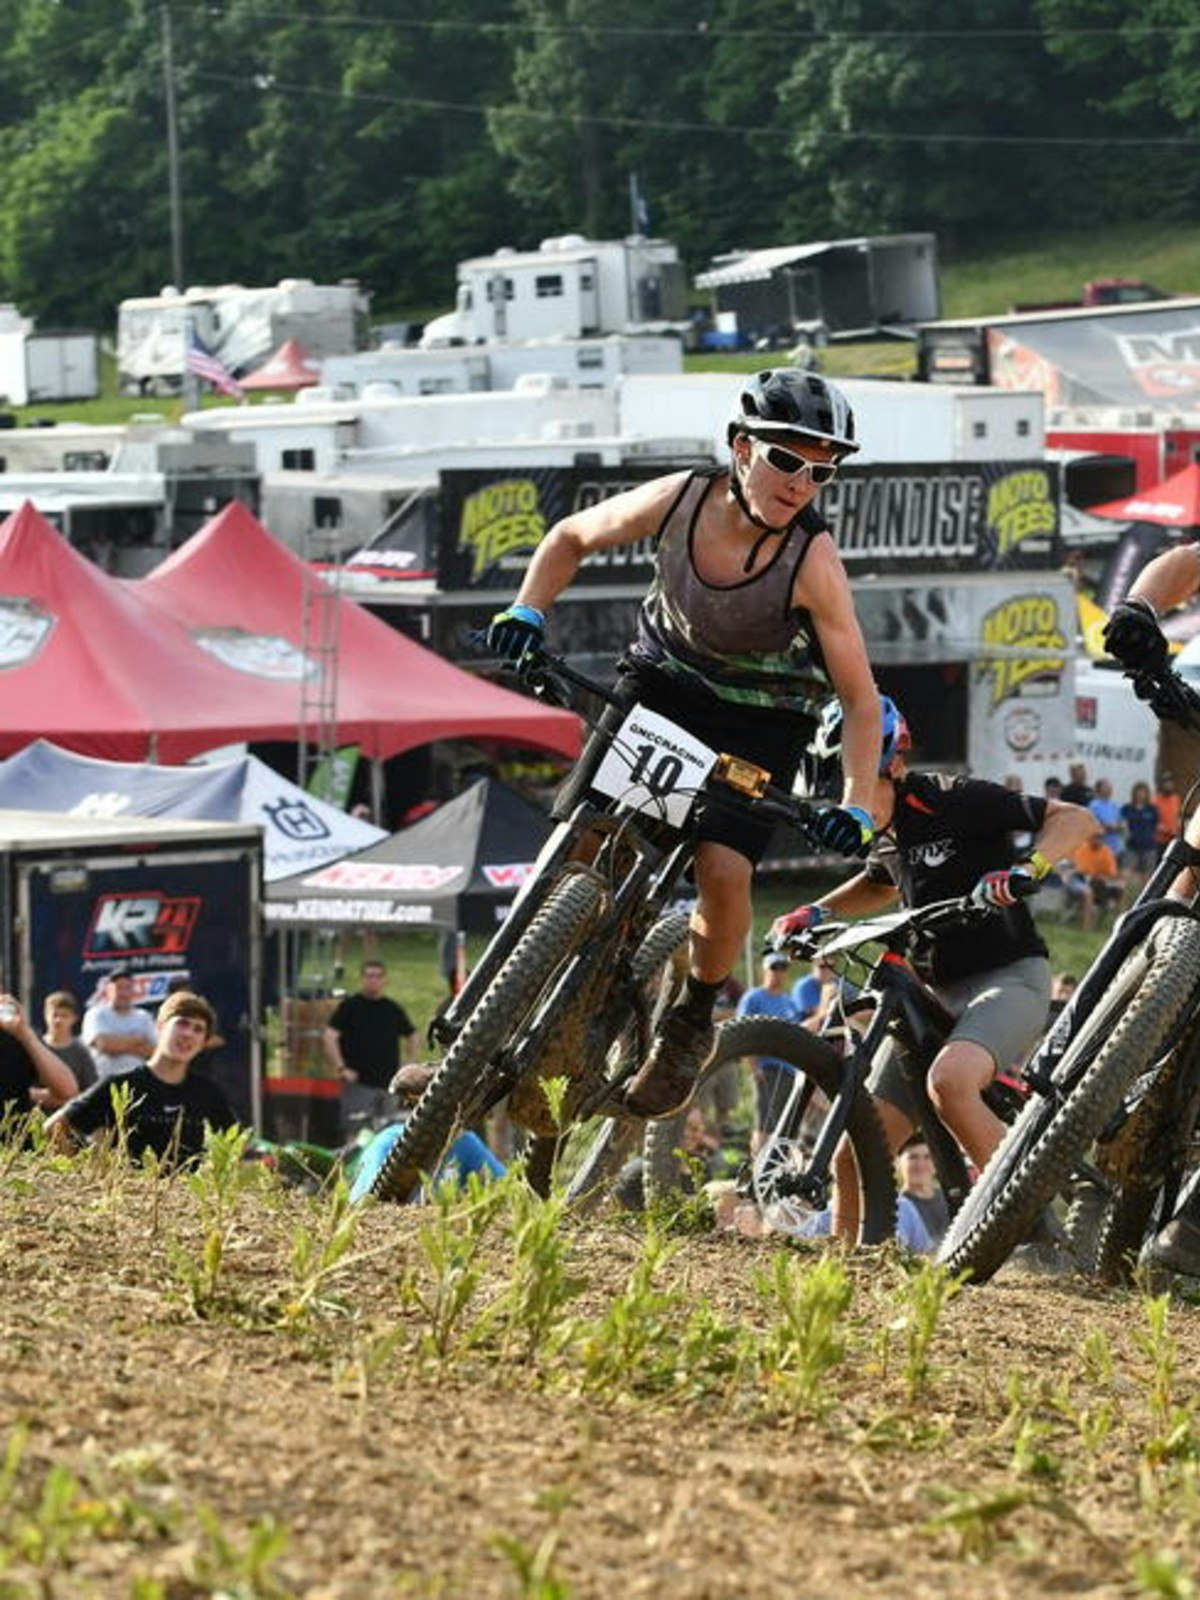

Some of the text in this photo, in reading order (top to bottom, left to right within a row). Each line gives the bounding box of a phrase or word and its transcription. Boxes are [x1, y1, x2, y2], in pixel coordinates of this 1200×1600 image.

[460, 480, 537, 546] MOTO
[814, 476, 982, 558] CHANDISE
[987, 470, 1048, 529] MOTO
[999, 502, 1056, 553] TEES
[470, 512, 547, 582] TEES
[983, 596, 1057, 652] MOTO
[628, 723, 706, 769] GNCCRACING
[629, 743, 684, 798] 10
